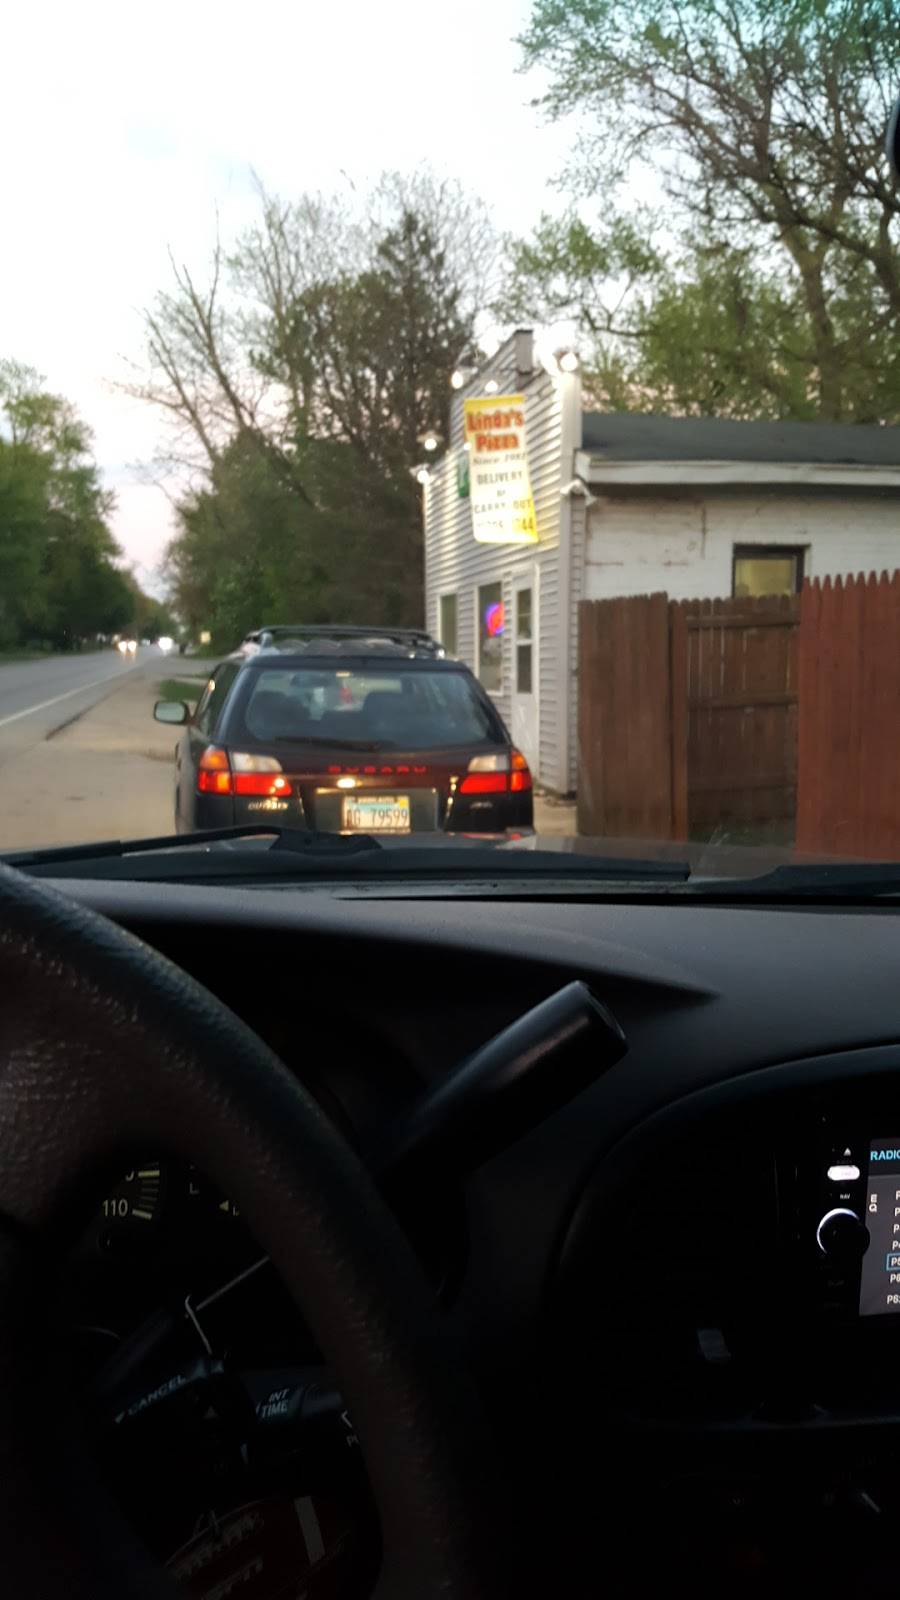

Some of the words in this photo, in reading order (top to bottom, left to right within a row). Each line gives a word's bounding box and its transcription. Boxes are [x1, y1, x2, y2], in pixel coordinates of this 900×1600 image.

[467, 410, 523, 431] Linda's
[477, 471, 522, 485] DELIVERY
[474, 501, 506, 514] CARRY
[328, 765, 427, 773] SUBARU
[102, 1198, 129, 1217] 110
[127, 1375, 189, 1416] CANCEL
[261, 1400, 290, 1418] TIME
